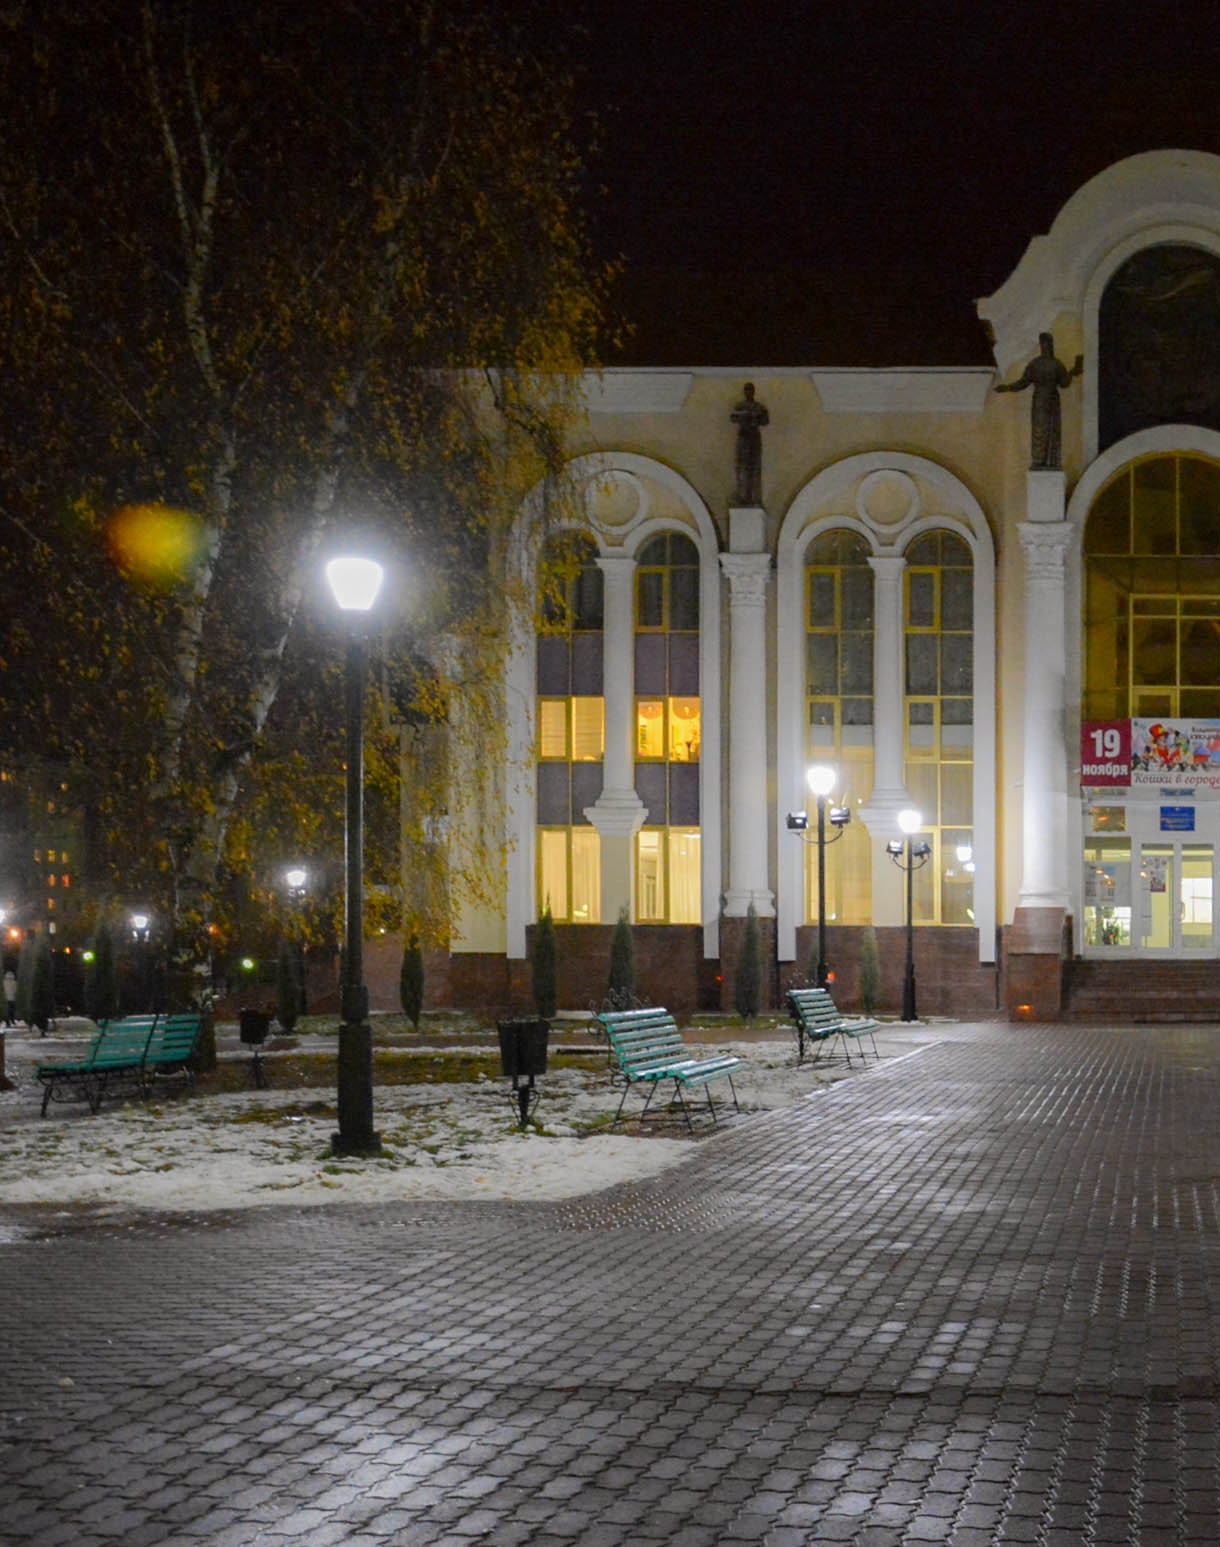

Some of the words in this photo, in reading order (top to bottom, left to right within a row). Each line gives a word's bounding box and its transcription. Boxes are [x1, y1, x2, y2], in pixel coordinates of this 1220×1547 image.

[1091, 728, 1120, 758] 19
[1082, 764, 1129, 778] ноября
[1134, 773, 1172, 784] Кошки
[1175, 774, 1182, 784] в
